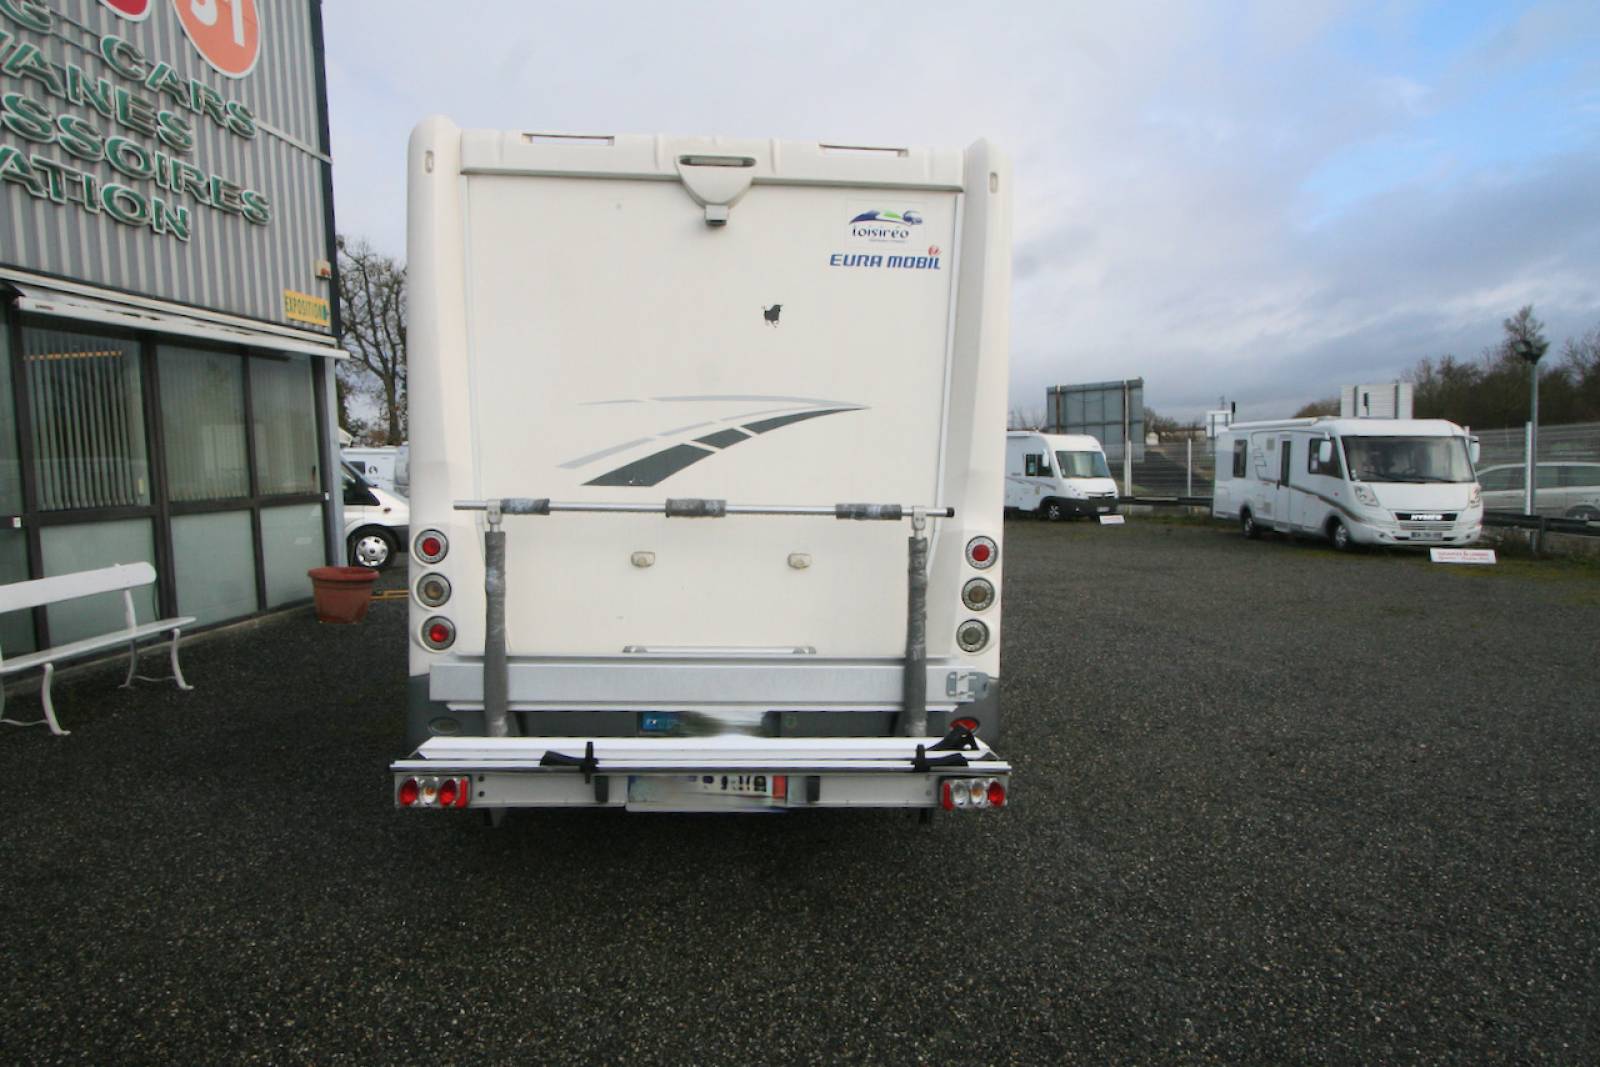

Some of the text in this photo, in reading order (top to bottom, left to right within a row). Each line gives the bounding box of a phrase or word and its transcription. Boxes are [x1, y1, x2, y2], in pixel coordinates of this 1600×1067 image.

[100, 34, 257, 139] CARS
[0, 145, 190, 242] ATION
[829, 253, 941, 270] EURA MOBIL
